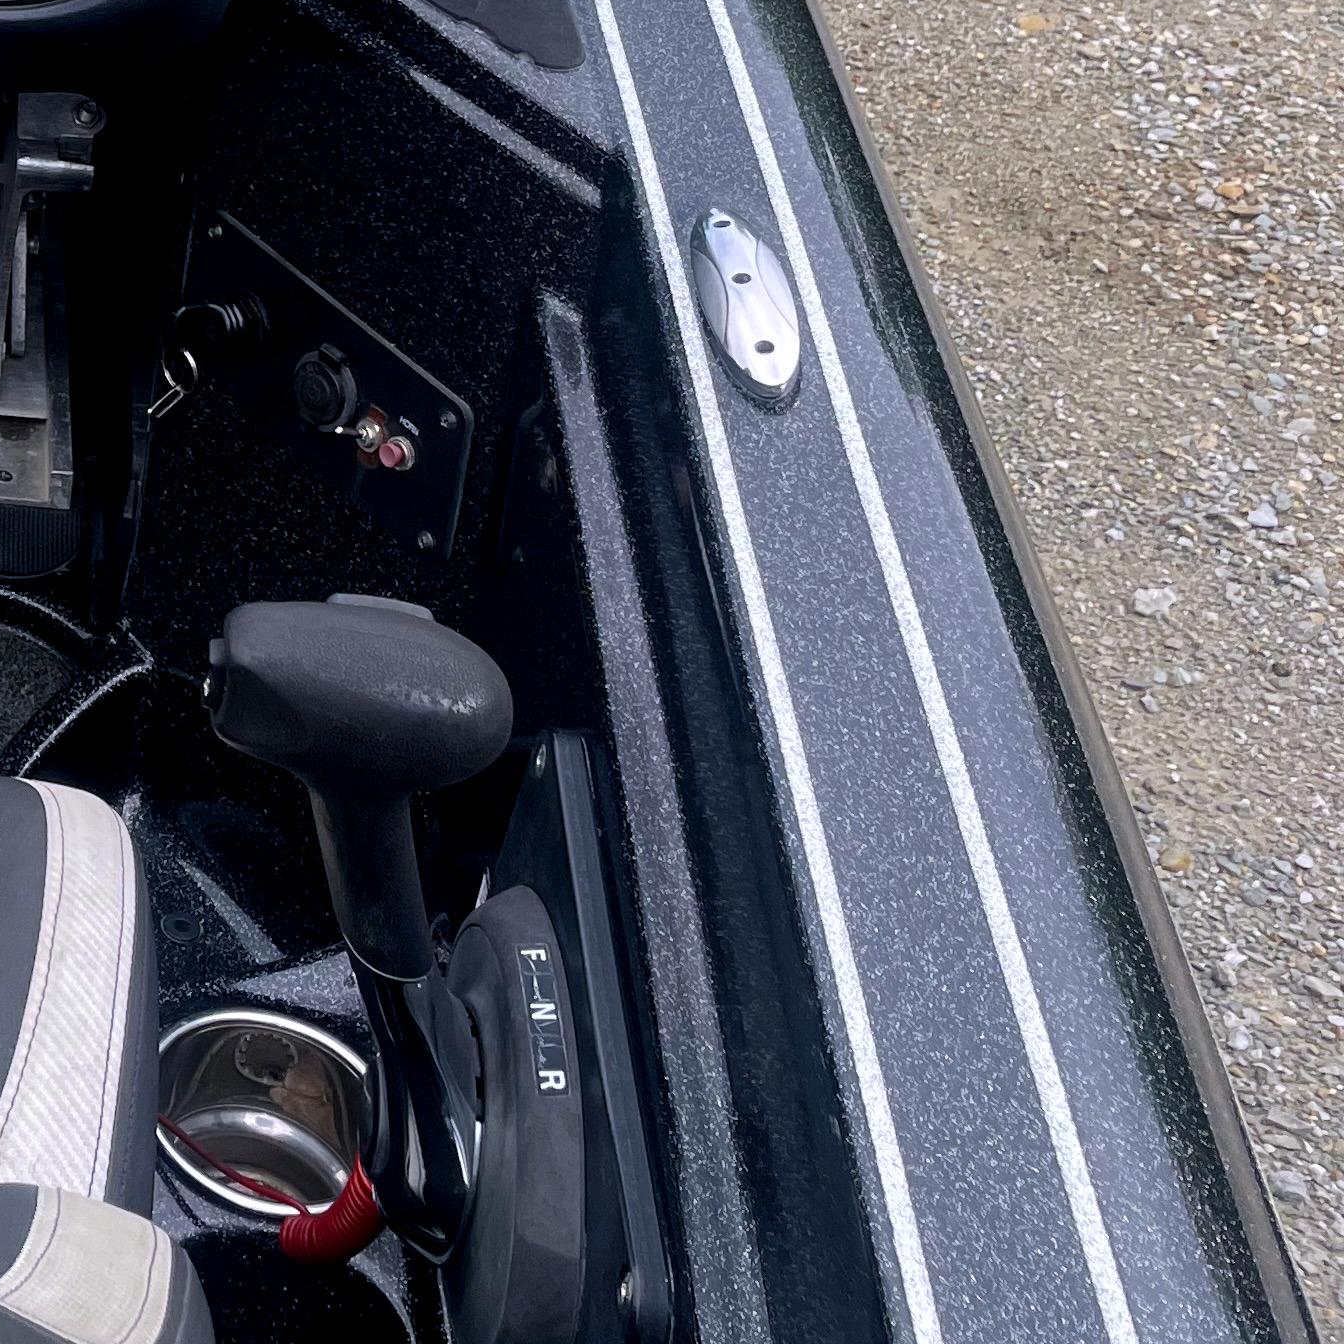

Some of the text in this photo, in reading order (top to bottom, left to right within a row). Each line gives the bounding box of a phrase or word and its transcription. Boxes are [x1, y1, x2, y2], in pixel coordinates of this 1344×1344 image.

[520, 949, 566, 1090] F N R
